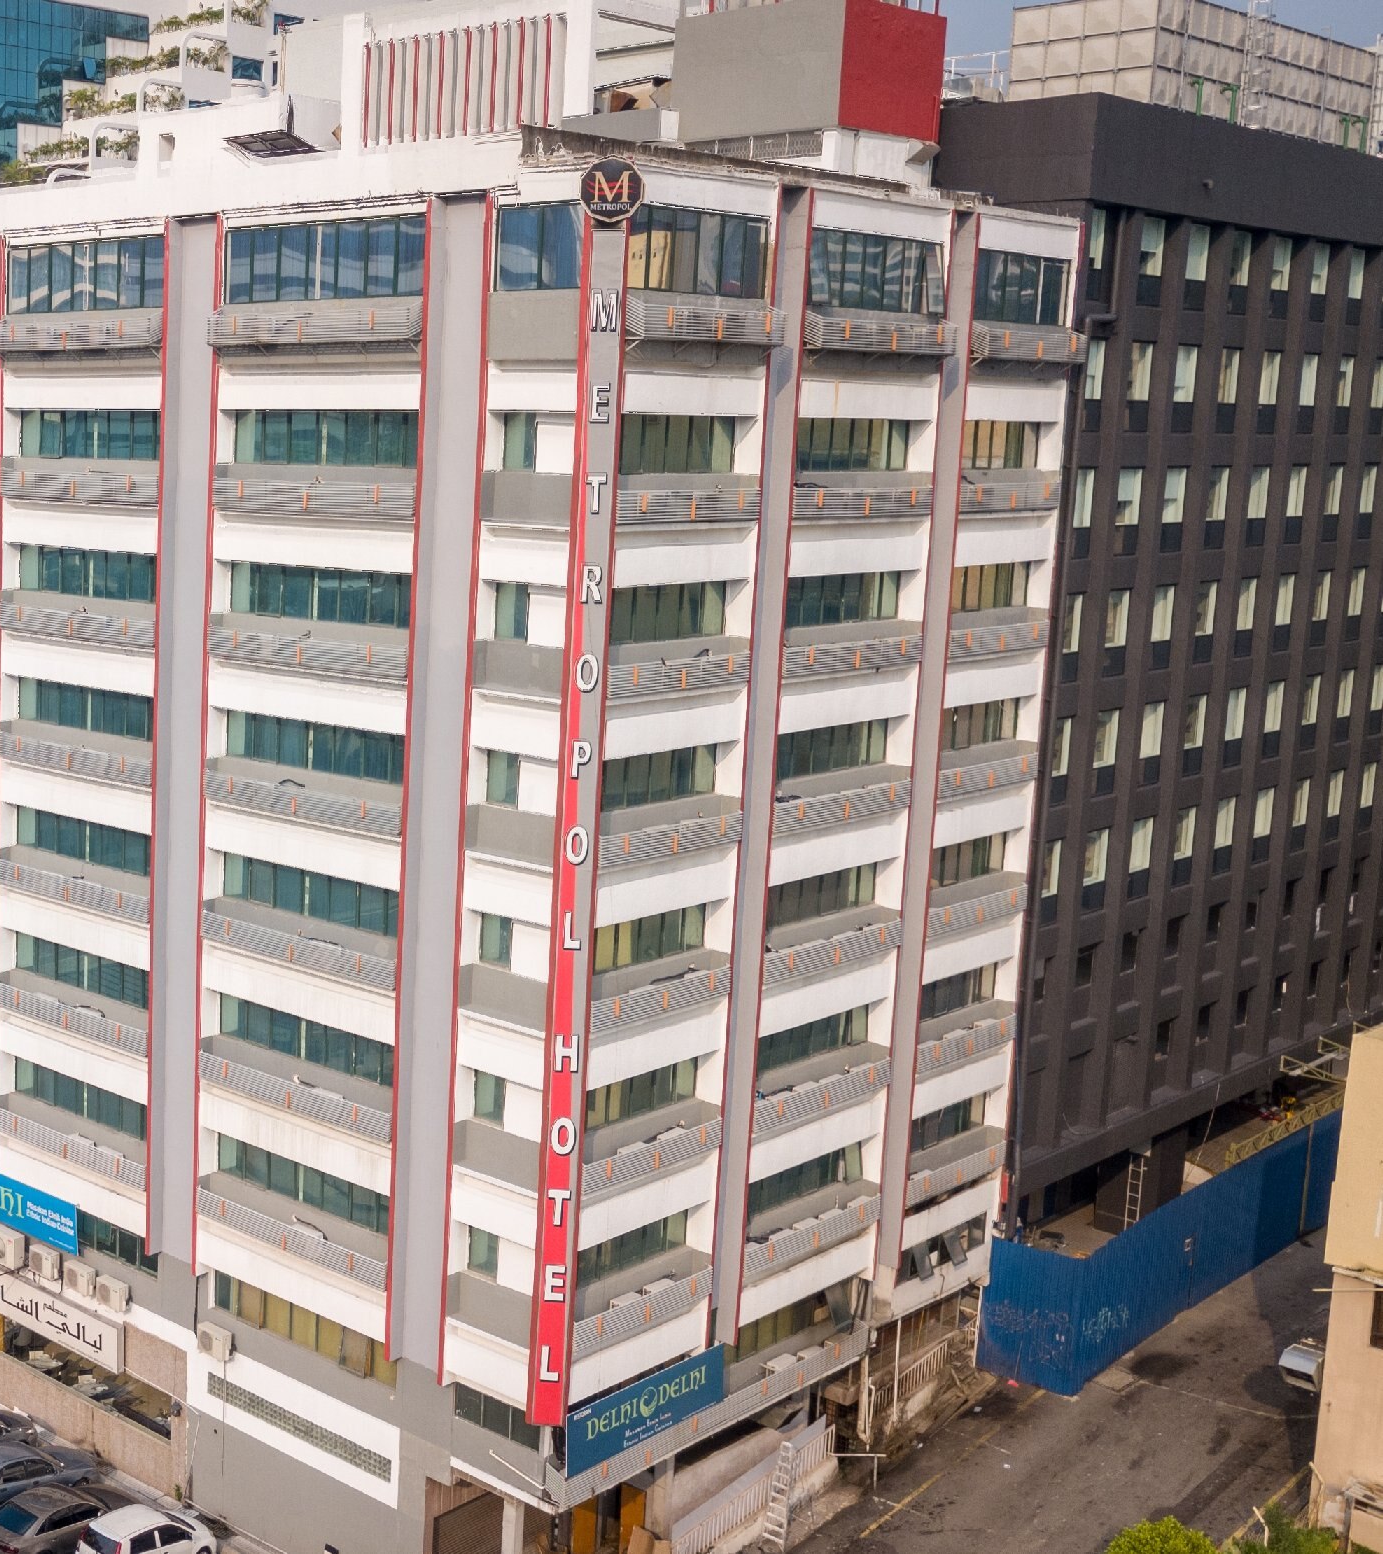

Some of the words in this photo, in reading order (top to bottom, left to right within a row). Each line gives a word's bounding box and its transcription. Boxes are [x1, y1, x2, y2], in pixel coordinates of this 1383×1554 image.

[590, 170, 634, 203] M
[590, 202, 632, 211] METROPOL
[563, 288, 618, 951] METROPOL
[539, 1034, 579, 1383] HOTEL
